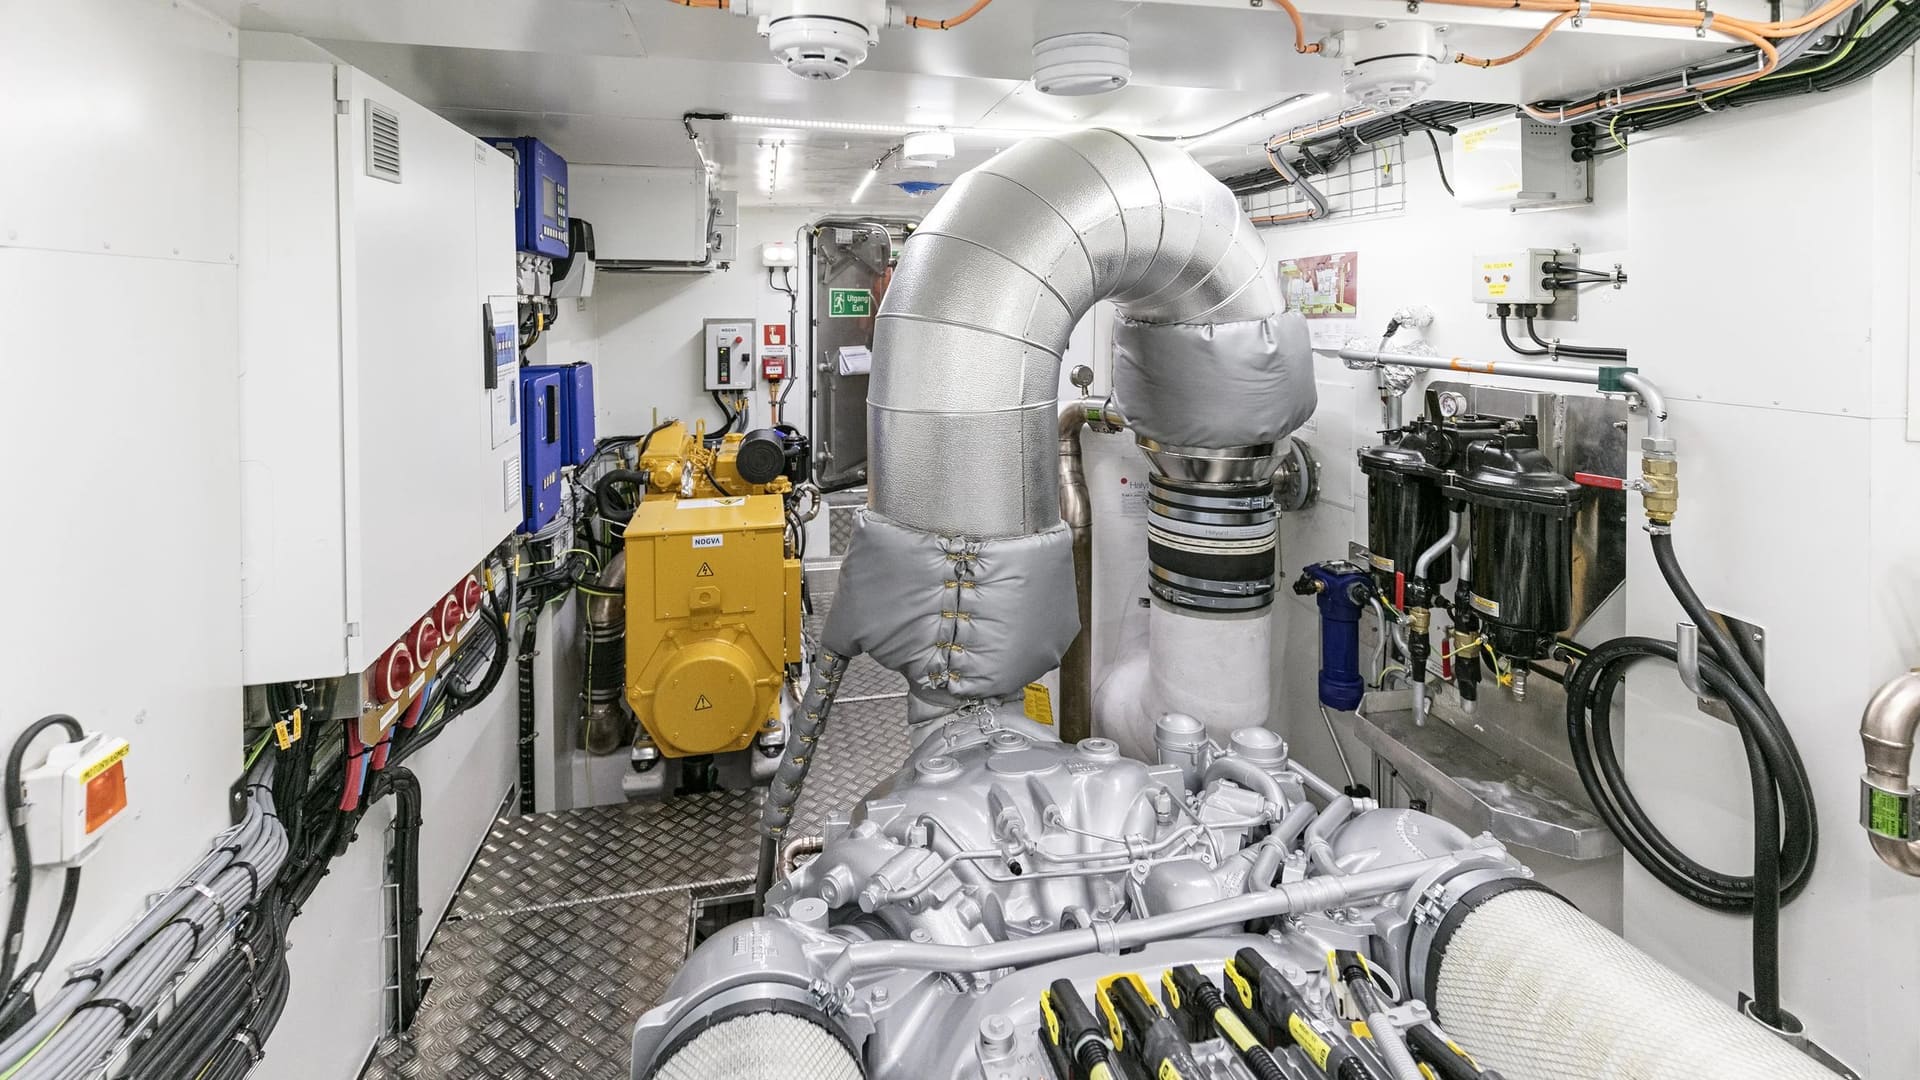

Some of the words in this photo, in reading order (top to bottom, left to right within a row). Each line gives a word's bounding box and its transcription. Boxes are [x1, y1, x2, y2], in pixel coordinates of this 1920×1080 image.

[847, 294, 869, 304] Utgang
[852, 304, 864, 312] Exit
[694, 537, 721, 546] NOGVA
